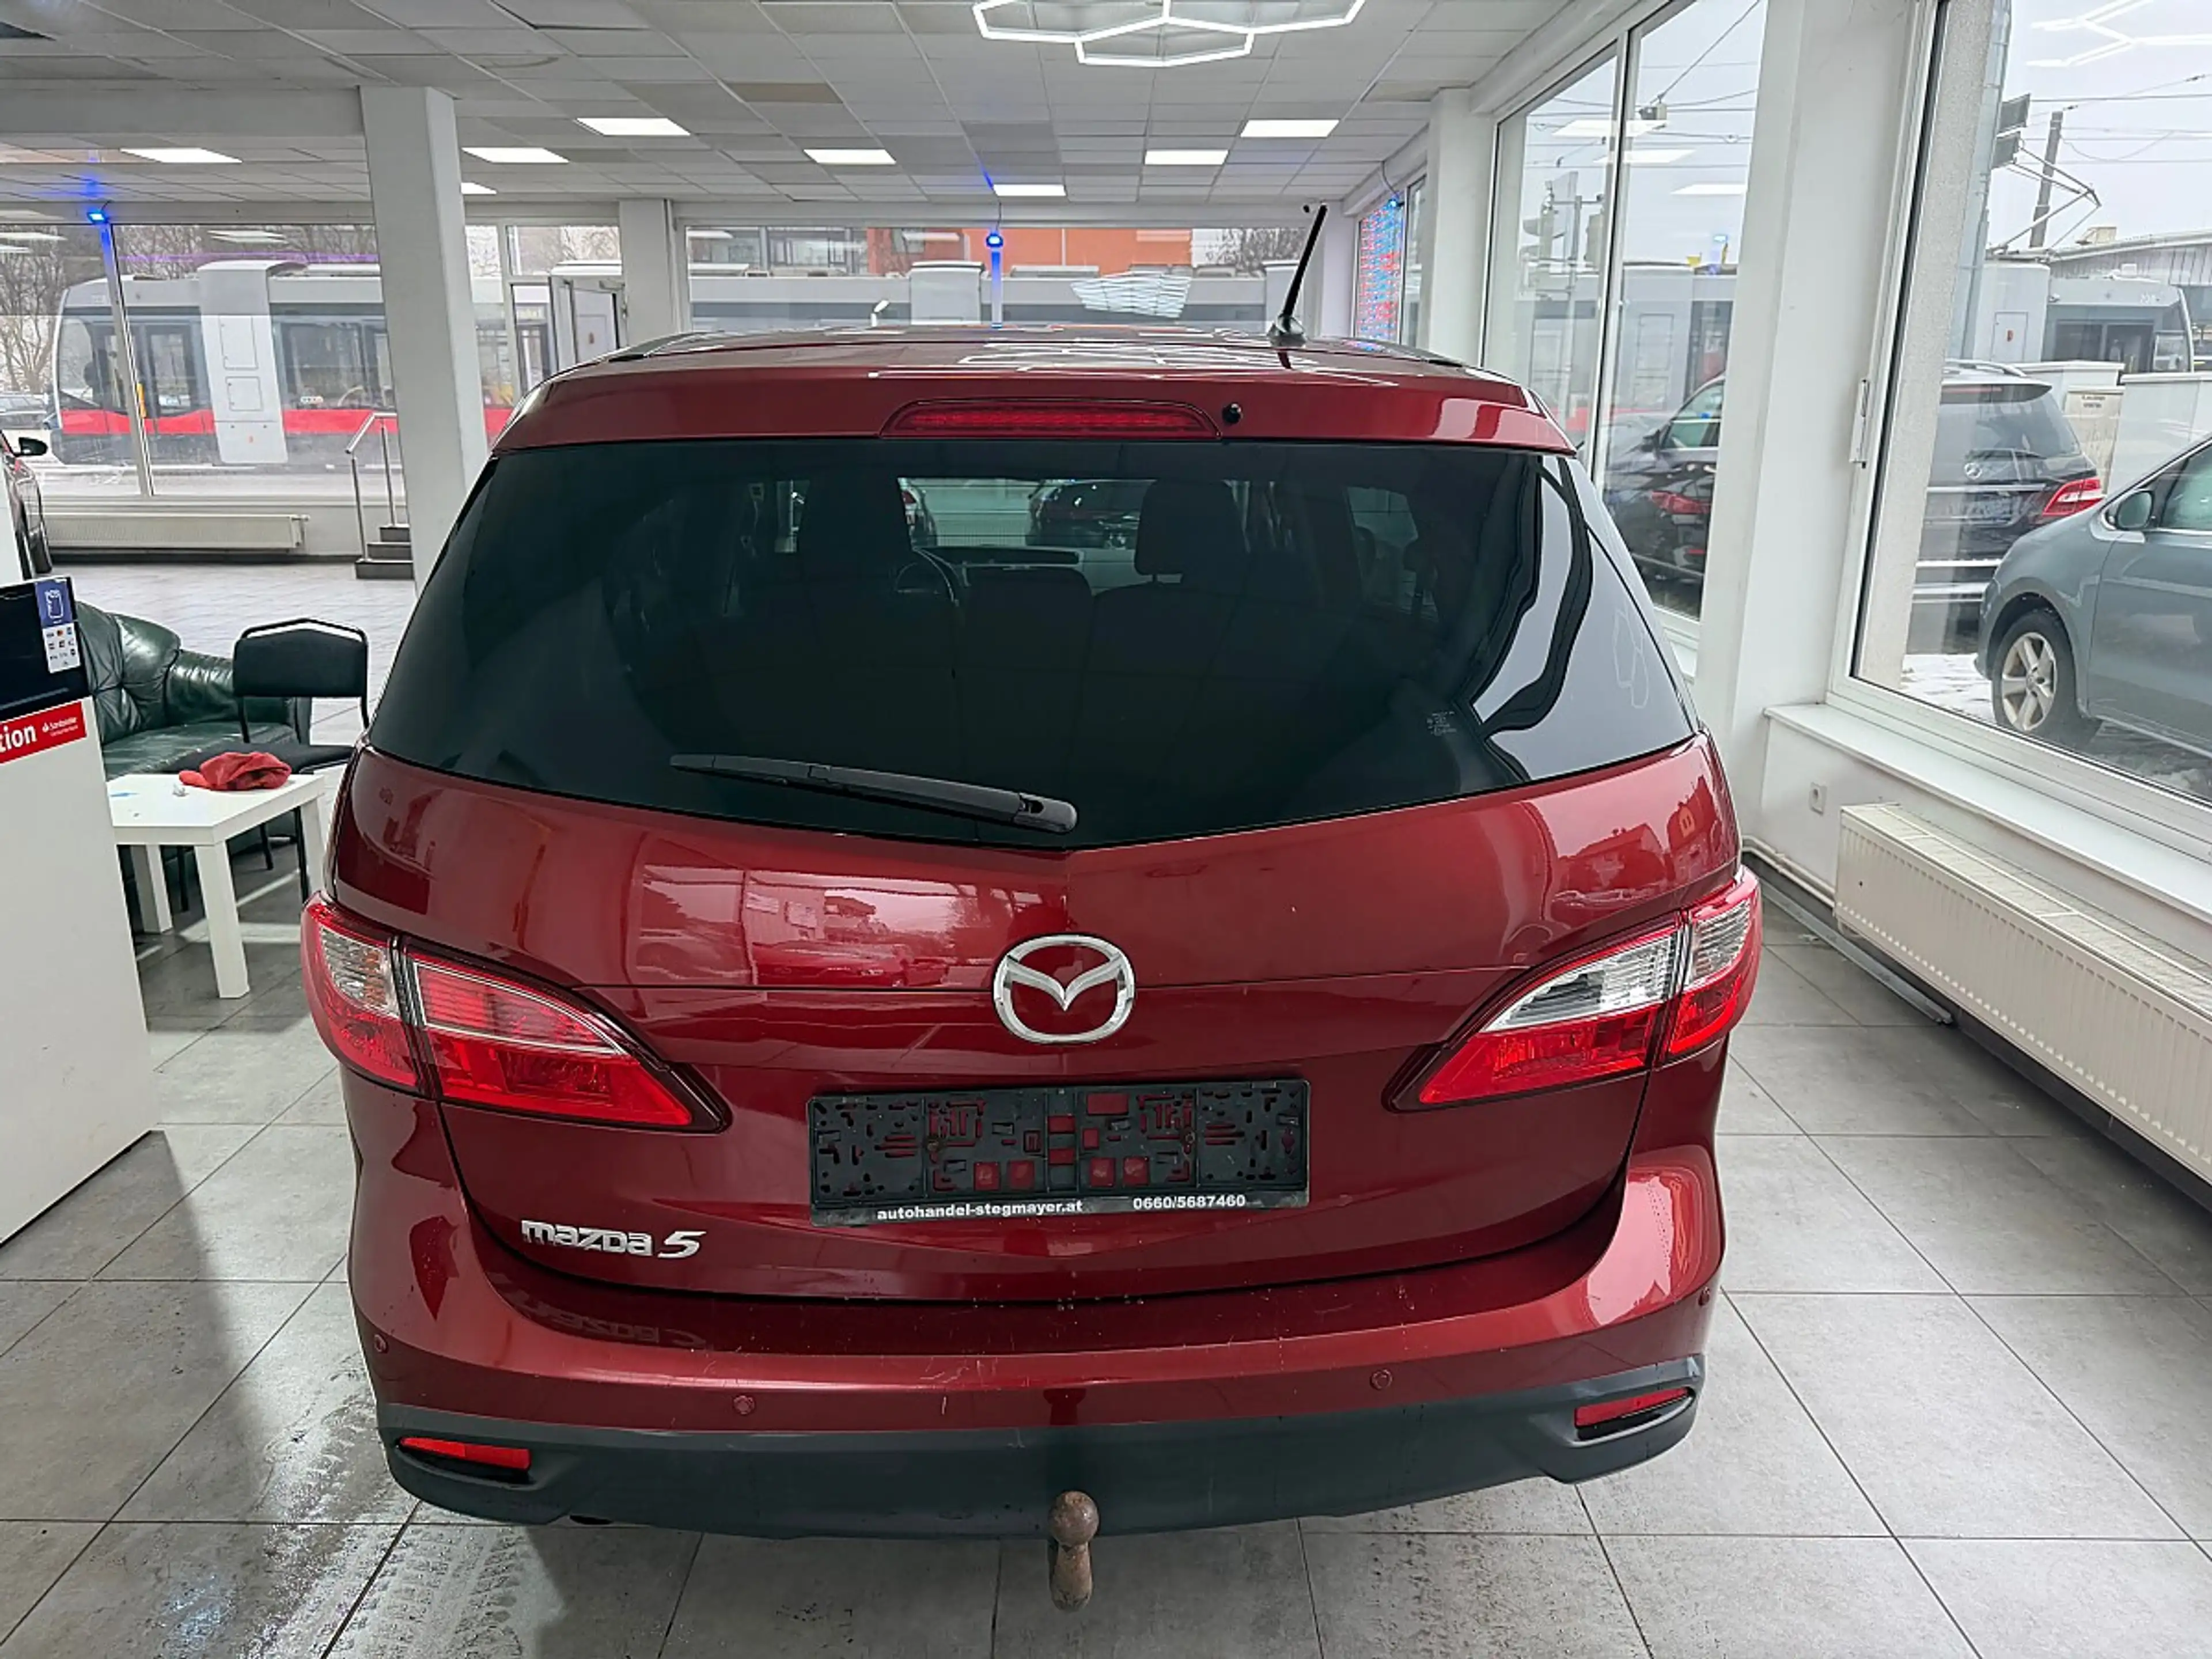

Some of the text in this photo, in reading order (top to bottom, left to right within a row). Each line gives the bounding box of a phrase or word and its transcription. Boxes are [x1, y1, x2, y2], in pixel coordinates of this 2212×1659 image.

[877, 1194, 1246, 1219] autohandel-stegmayer.at 0660/5687460
[657, 1230, 707, 1258] 5
